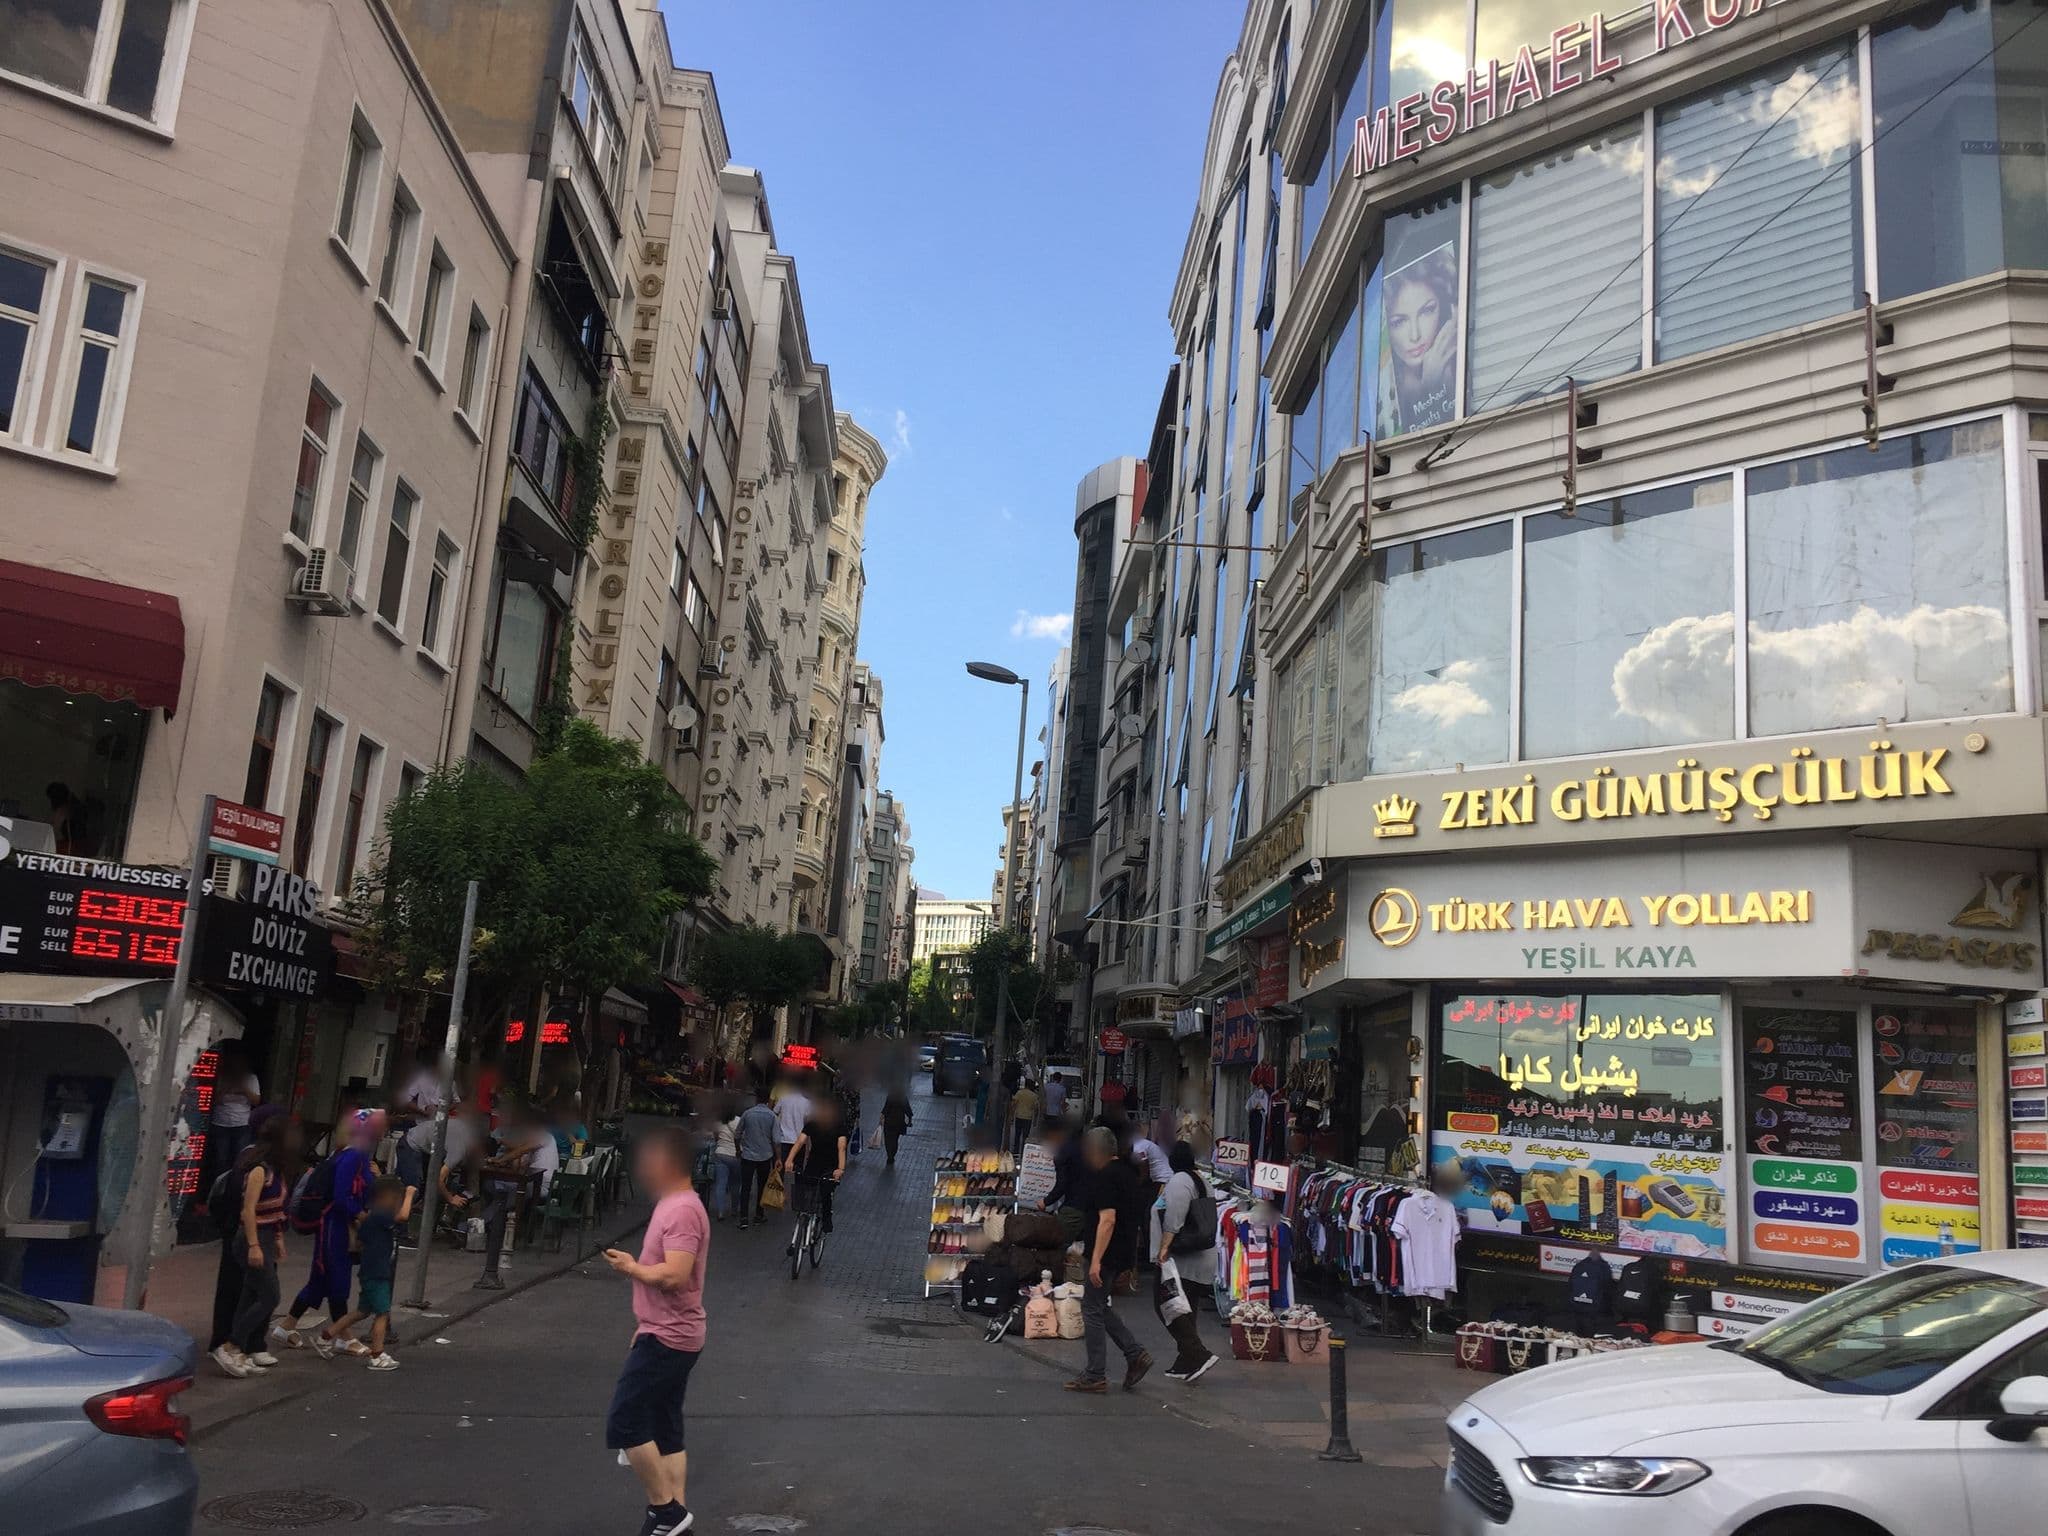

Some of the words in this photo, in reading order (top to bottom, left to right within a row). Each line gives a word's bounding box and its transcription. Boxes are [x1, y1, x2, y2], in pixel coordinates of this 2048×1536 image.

[1353, 13, 1622, 177] MESHAEL
[631, 241, 666, 395] HOTEL
[727, 480, 757, 601] HOTEL
[587, 437, 645, 706] METROLUX
[702, 634, 737, 843] GLORIOUS
[1439, 773, 1537, 829] ZEKİ
[1550, 739, 1953, 823] GÜMÜŞÇÜLÜK
[217, 806, 281, 835] YEŞİLTULUMBA
[92, 861, 183, 890] MÜESSESE
[252, 862, 320, 920] PARS
[47, 904, 73, 916] BUY
[49, 891, 74, 903] EUR
[1427, 897, 1514, 932] TÜRK
[1523, 896, 1632, 930] HAVA
[1641, 889, 1812, 927] YOLLARI
[40, 940, 67, 953] SELL
[44, 926, 69, 939] EUR
[252, 915, 308, 957] DÖVİZ
[228, 951, 318, 996] EXCHANGE
[1522, 942, 1606, 974] YEŞİL
[1615, 945, 1697, 969] KAYA
[1218, 1145, 1238, 1160] 20
[1260, 1166, 1279, 1181] 10
[1737, 1301, 1790, 1314] MoneyGram
